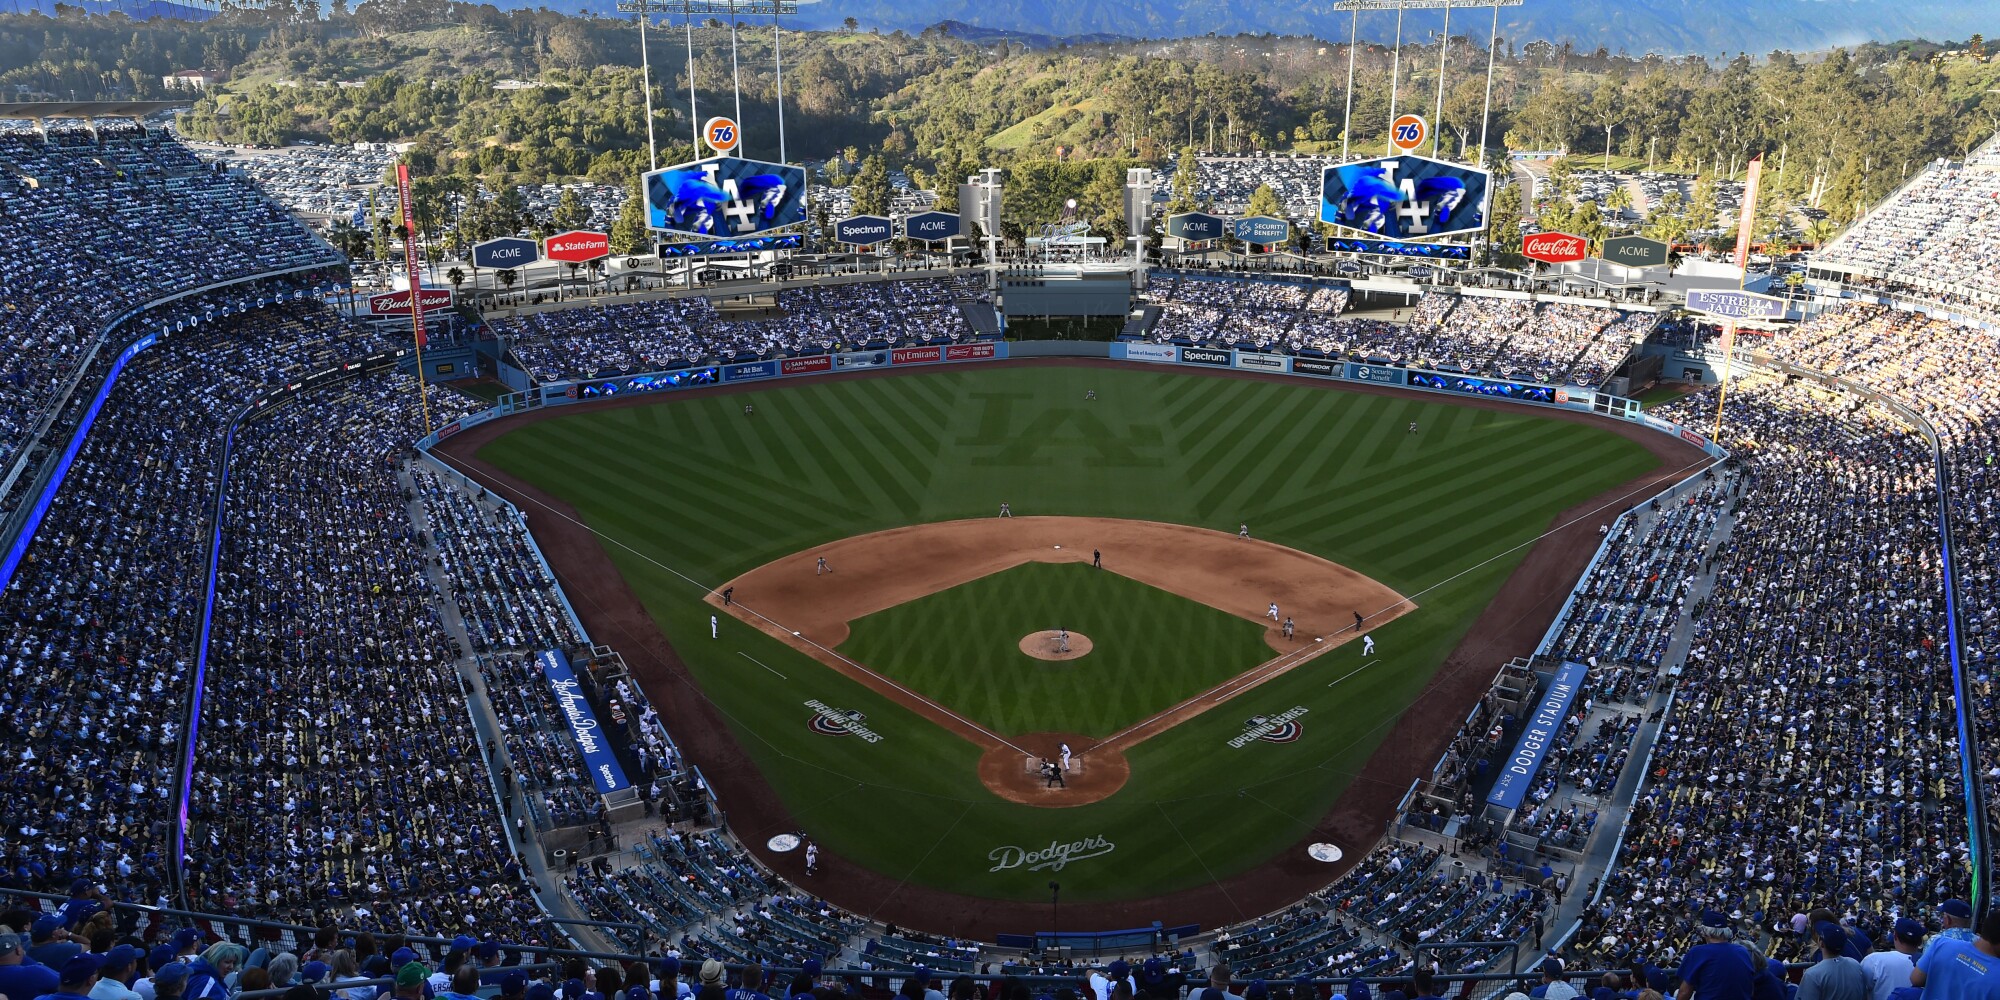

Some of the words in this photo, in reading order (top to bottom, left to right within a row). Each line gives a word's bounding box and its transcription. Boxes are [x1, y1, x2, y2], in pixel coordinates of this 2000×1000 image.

[713, 126, 733, 142] 76
[1396, 124, 1419, 141] 76
[402, 180, 410, 207] Emirates
[842, 226, 885, 236] Spectrum
[920, 221, 946, 231] ACME
[1040, 219, 1092, 241] Dodgers
[1182, 222, 1208, 232] ACME
[408, 236, 417, 265] Emirates
[491, 248, 522, 259] ACME
[1528, 238, 1576, 256] Coca-Cola
[1619, 246, 1649, 257] ACME
[1410, 267, 1432, 276] DASANI
[374, 296, 449, 312] Budeiser
[414, 291, 422, 319] Emirates
[1700, 293, 1774, 310] ESTRELLA
[1706, 304, 1766, 316] JALISCO
[893, 352, 906, 361] Fly
[907, 350, 939, 359] Emirates
[1184, 351, 1226, 362] Spectrum
[1371, 368, 1394, 376] Security
[545, 651, 558, 668] Spectrum
[552, 679, 577, 696] Los
[560, 692, 586, 723] Angeles
[804, 699, 850, 724] OPENING
[842, 721, 884, 743] SERIES
[1226, 723, 1276, 748] OPENING
[1270, 706, 1309, 726] SERIES
[1511, 729, 1548, 775] DODGER
[1537, 684, 1571, 726] STADIUM
[574, 719, 600, 754] Dodgers
[599, 764, 616, 788] Spectrum
[988, 834, 1115, 872] Dodgers
[735, 991, 756, 1000] PUIG
